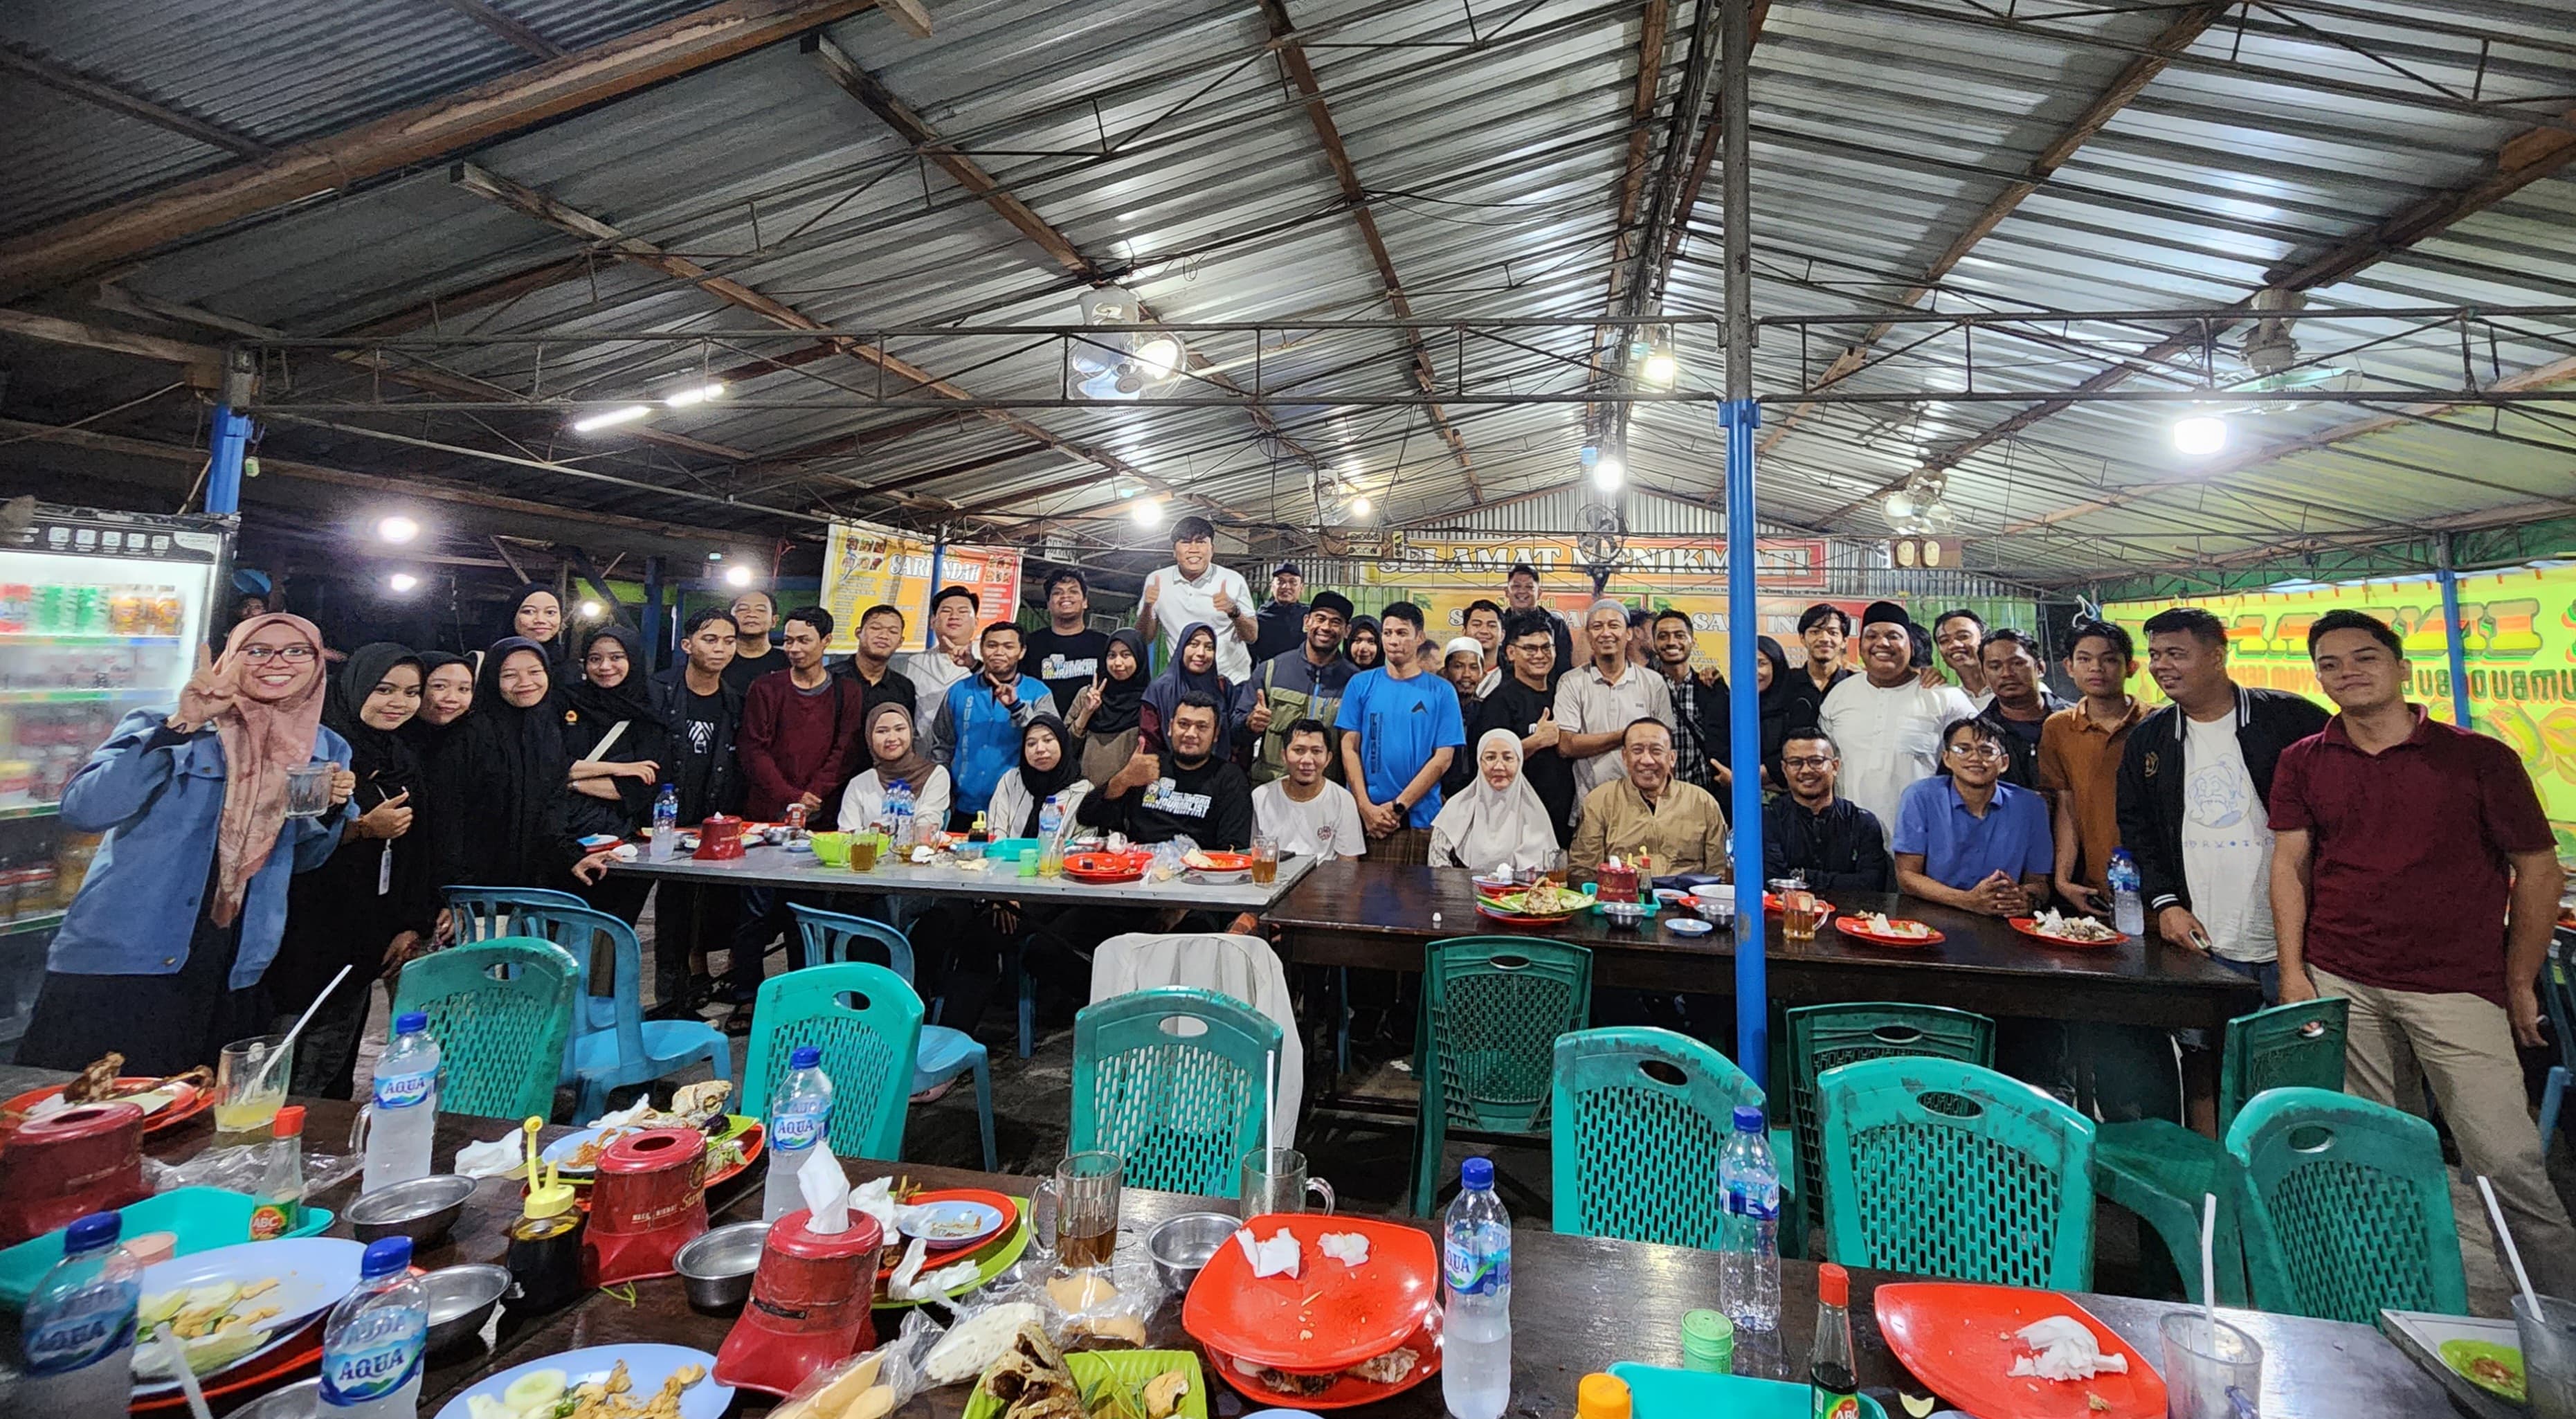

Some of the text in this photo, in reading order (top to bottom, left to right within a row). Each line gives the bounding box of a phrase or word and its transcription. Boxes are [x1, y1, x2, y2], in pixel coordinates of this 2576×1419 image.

[889, 554, 981, 582] SARI NDAH
[384, 1077, 425, 1094] AQUA
[778, 1119, 815, 1136] AQUA
[253, 1215, 280, 1228] ABC
[1445, 1249, 1471, 1274] QUA
[35, 1320, 107, 1352] AQUA
[338, 1348, 405, 1381] AQUA
